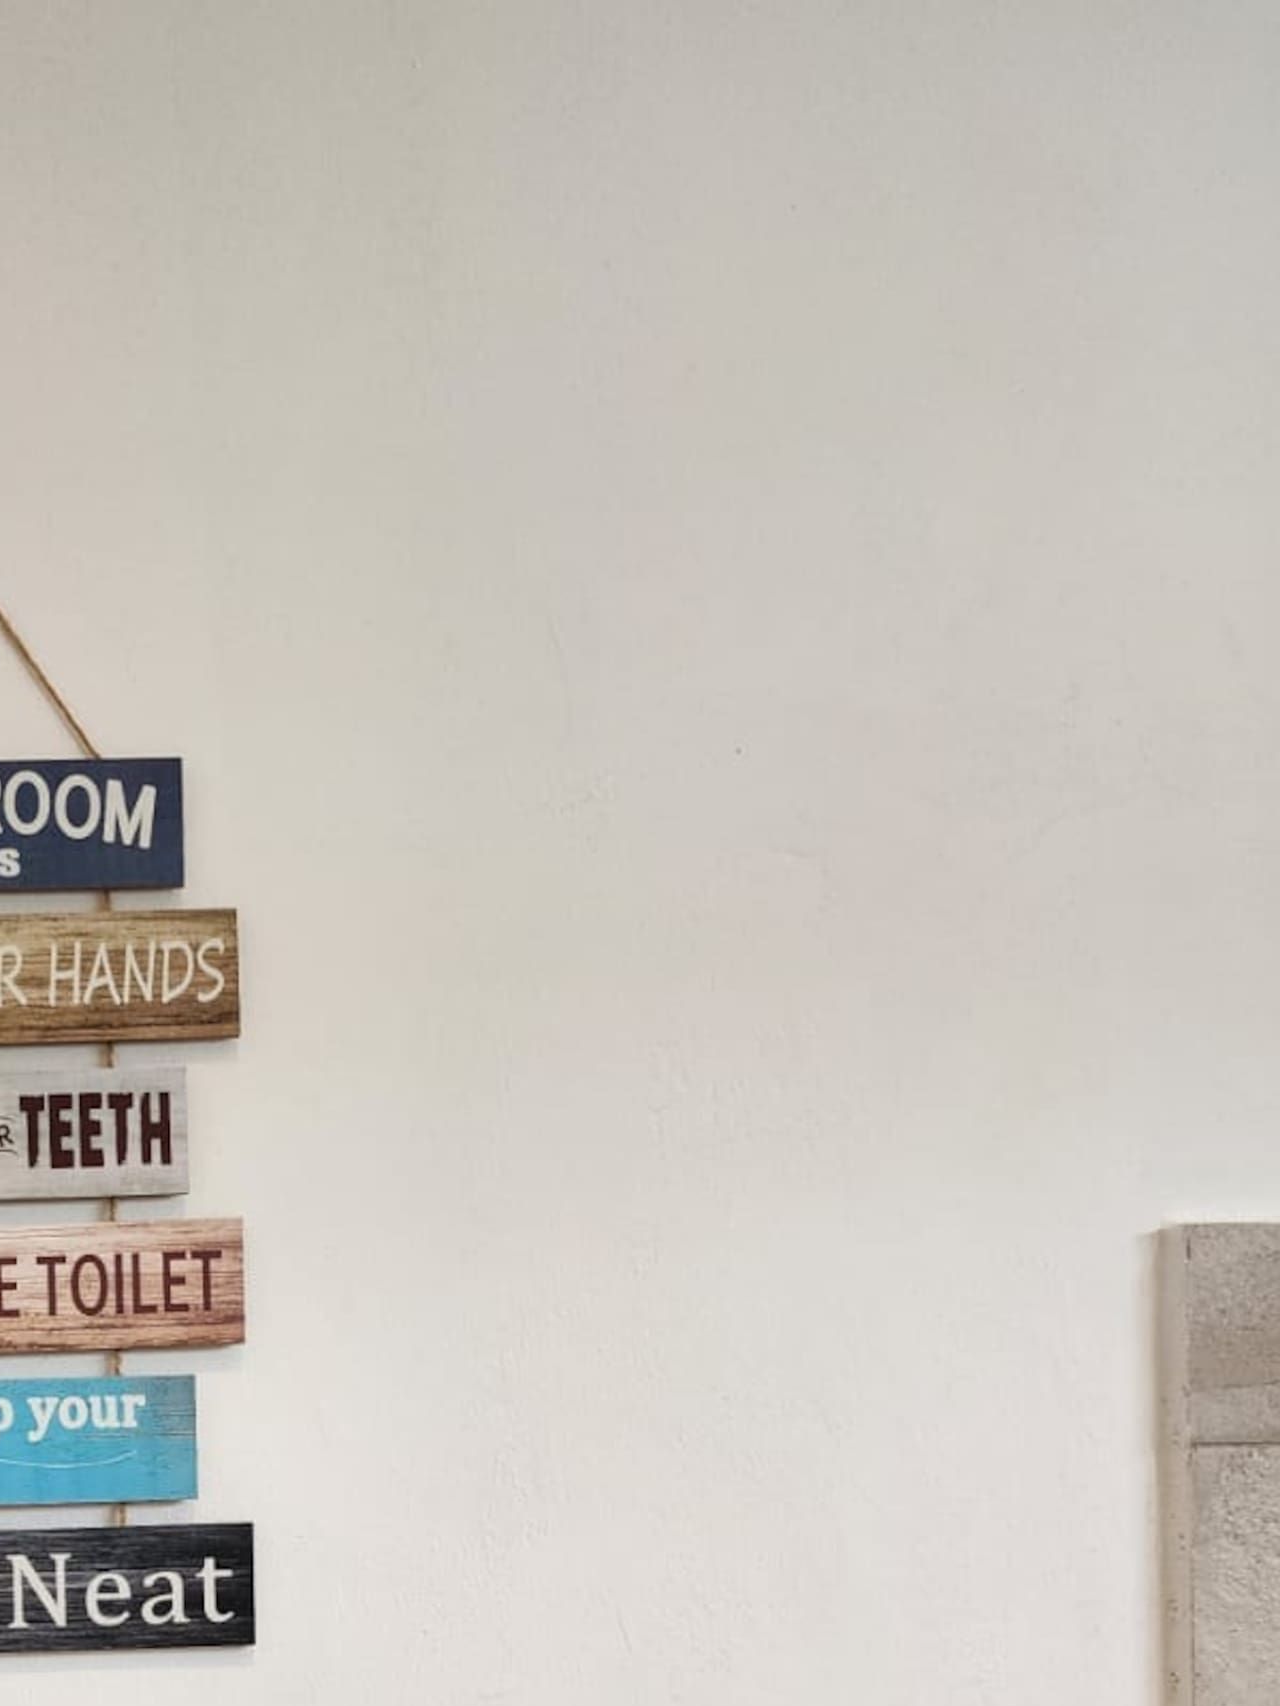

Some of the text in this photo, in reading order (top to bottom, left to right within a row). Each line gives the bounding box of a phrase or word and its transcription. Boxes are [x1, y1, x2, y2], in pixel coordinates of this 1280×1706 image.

[49, 937, 225, 1007] HANDS
[19, 1091, 173, 1169] TEETH
[36, 1249, 223, 1317] TOILET
[27, 1391, 147, 1443] your
[6, 1552, 236, 1629] Neat
